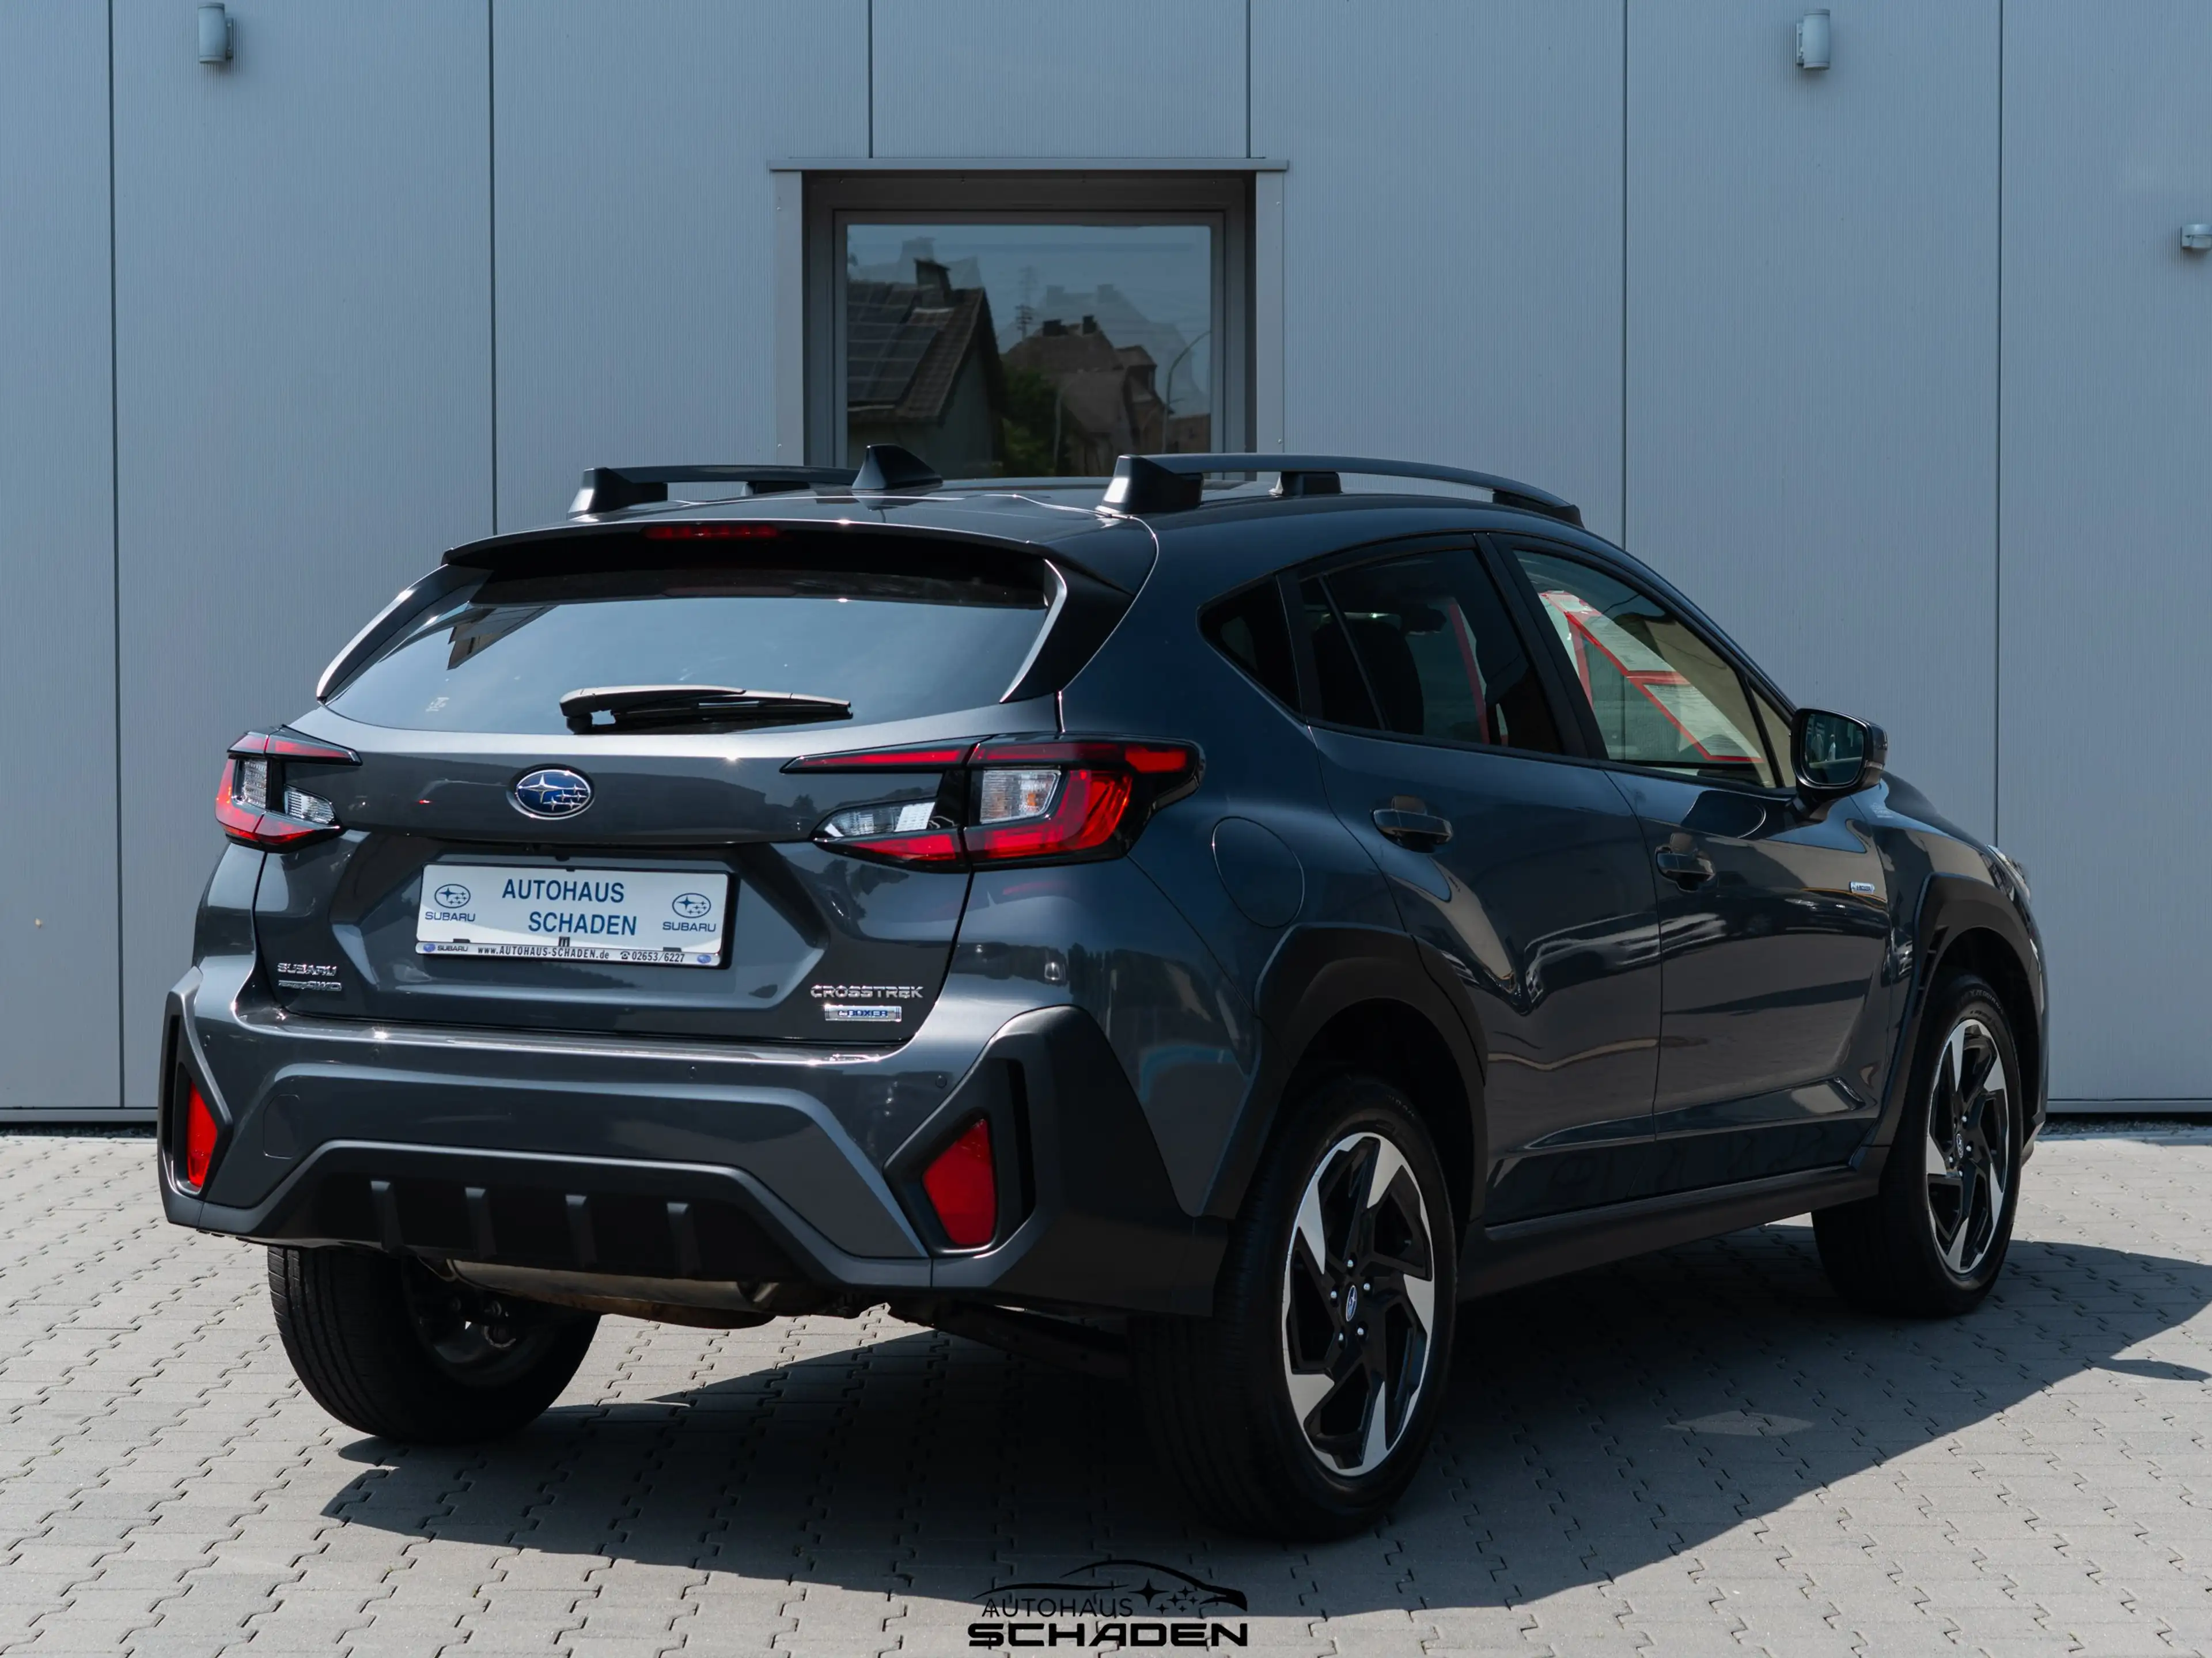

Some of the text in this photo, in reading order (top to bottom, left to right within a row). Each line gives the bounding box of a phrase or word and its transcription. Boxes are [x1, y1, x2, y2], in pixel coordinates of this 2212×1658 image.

[502, 879, 624, 902] AUTOHAUS
[425, 912, 476, 922] SUBARU
[528, 912, 637, 936] SCHADEN
[662, 921, 717, 932] SUBARU
[478, 945, 685, 963] www.AUTOHAUS-SCHADEN.de 02653/6227
[278, 963, 337, 976] SUBARU
[810, 985, 924, 998] CROSSTREK
